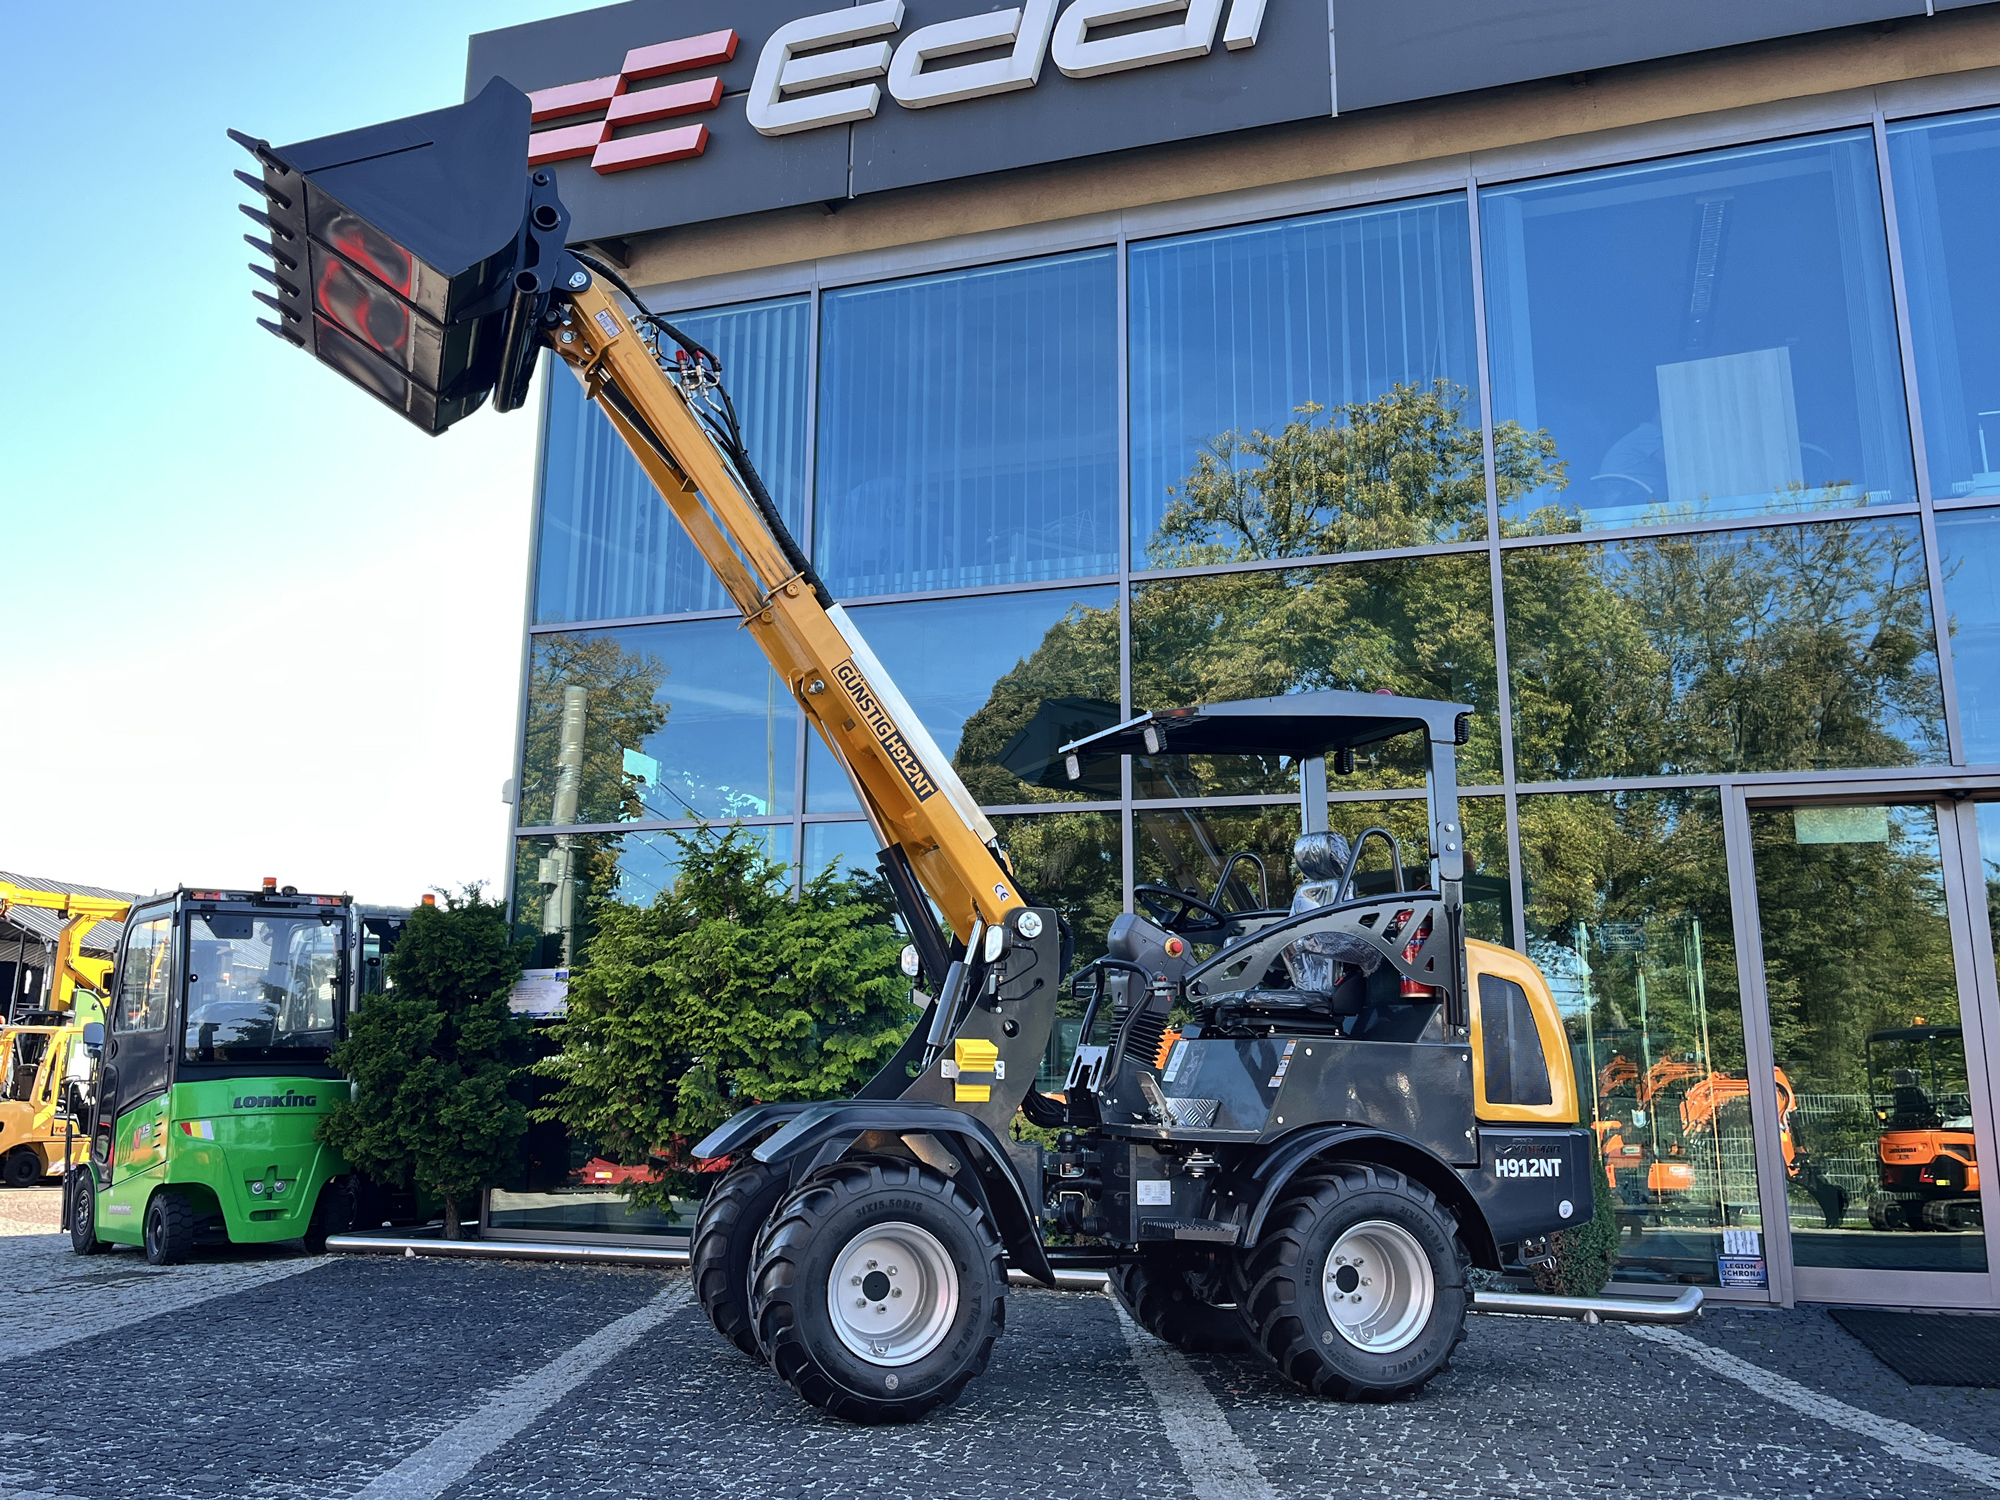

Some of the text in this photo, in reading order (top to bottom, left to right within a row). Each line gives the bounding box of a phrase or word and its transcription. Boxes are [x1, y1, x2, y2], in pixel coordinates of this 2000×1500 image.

[837, 665, 935, 797] GÜNSTIG H912NT
[1495, 1158, 1562, 1178] H912NT
[855, 1198, 923, 1218] 31X15.50R15
[950, 1295, 982, 1361] TIANLI
[1381, 1347, 1432, 1376] TIANLI
